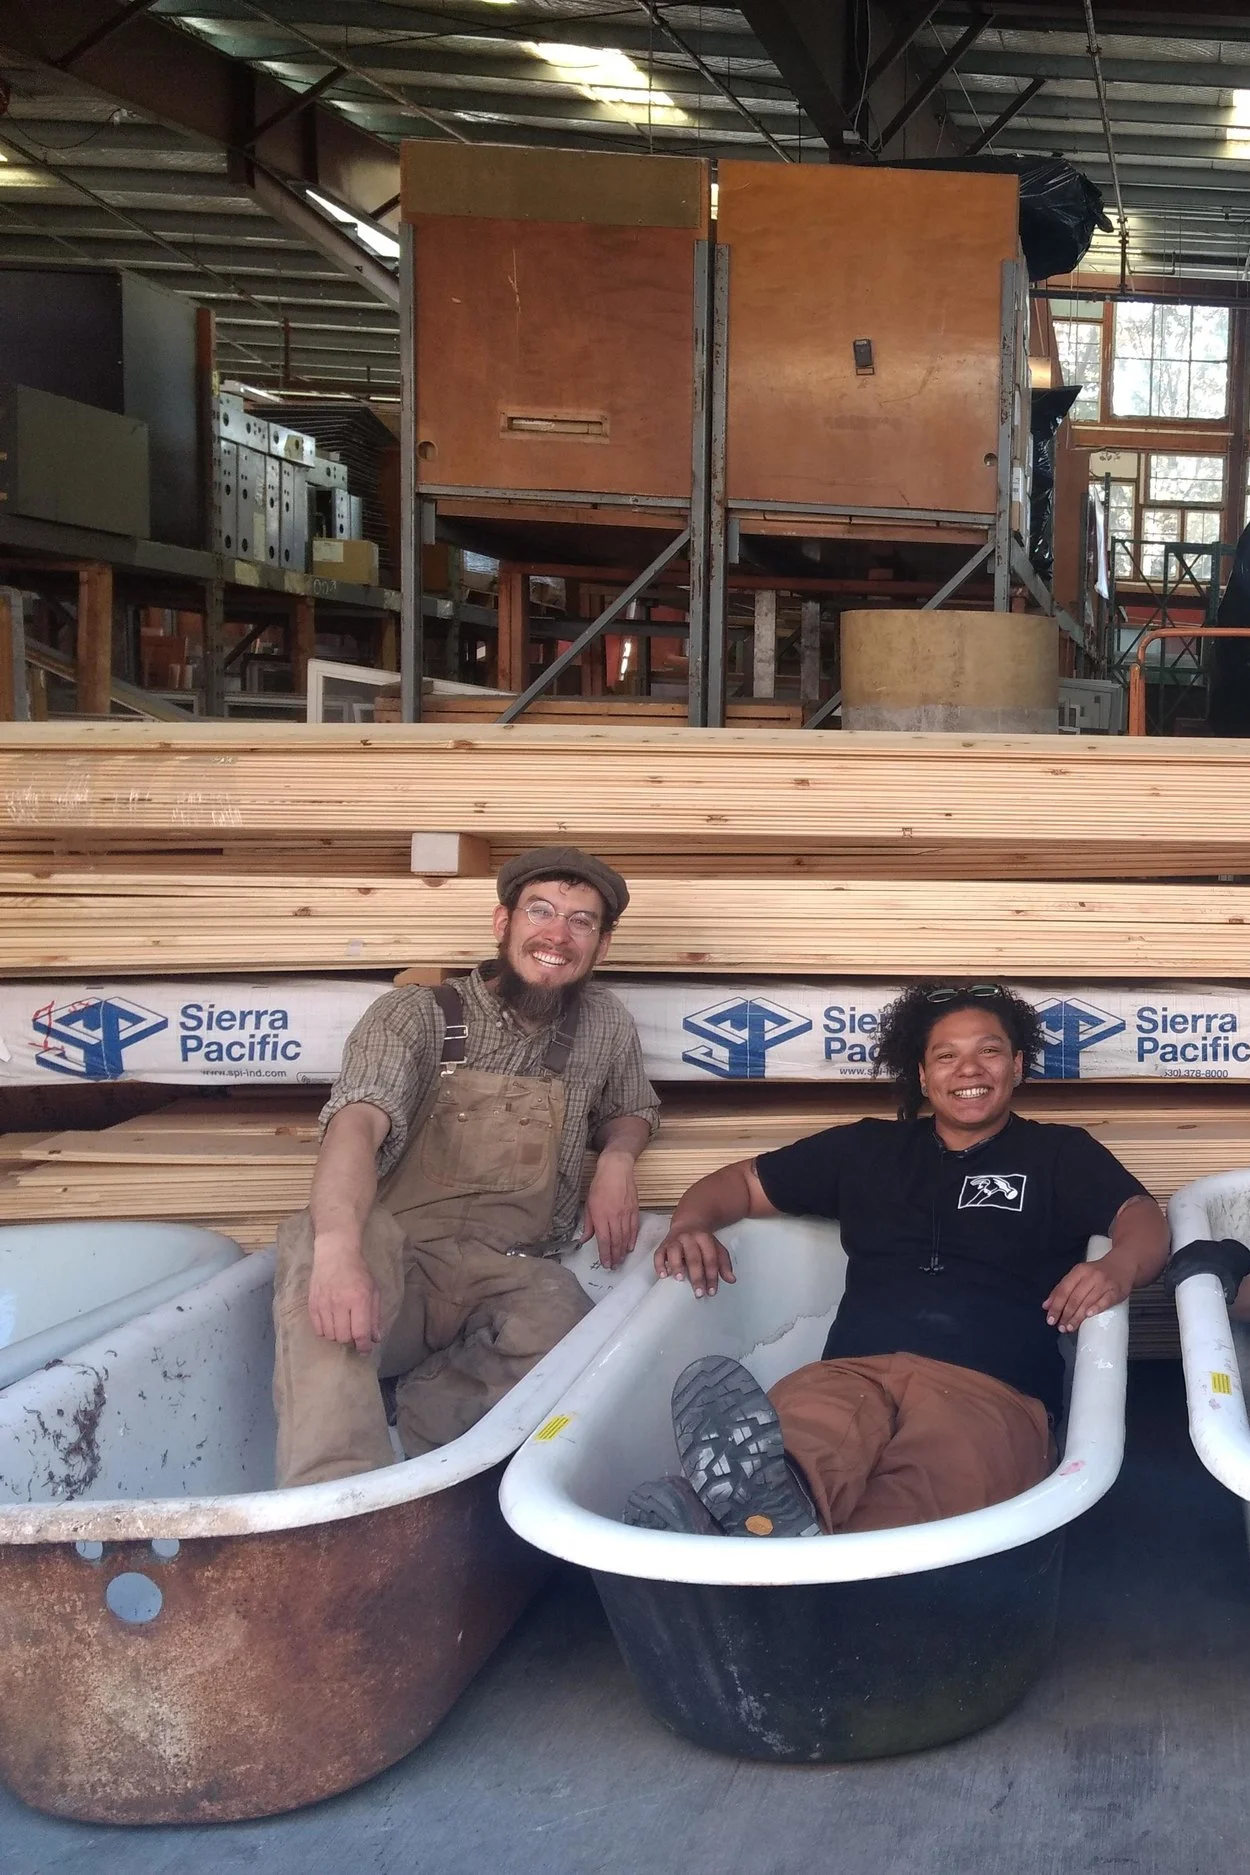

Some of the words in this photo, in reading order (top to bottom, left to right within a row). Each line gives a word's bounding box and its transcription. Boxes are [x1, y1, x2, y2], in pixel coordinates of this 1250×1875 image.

[180, 1003, 288, 1031] Sierra
[1136, 1006, 1237, 1033] Sierra
[181, 1034, 301, 1062] Pacific
[1138, 1036, 1250, 1062] Pacific
[1184, 1069, 1228, 1078] 378-8000
